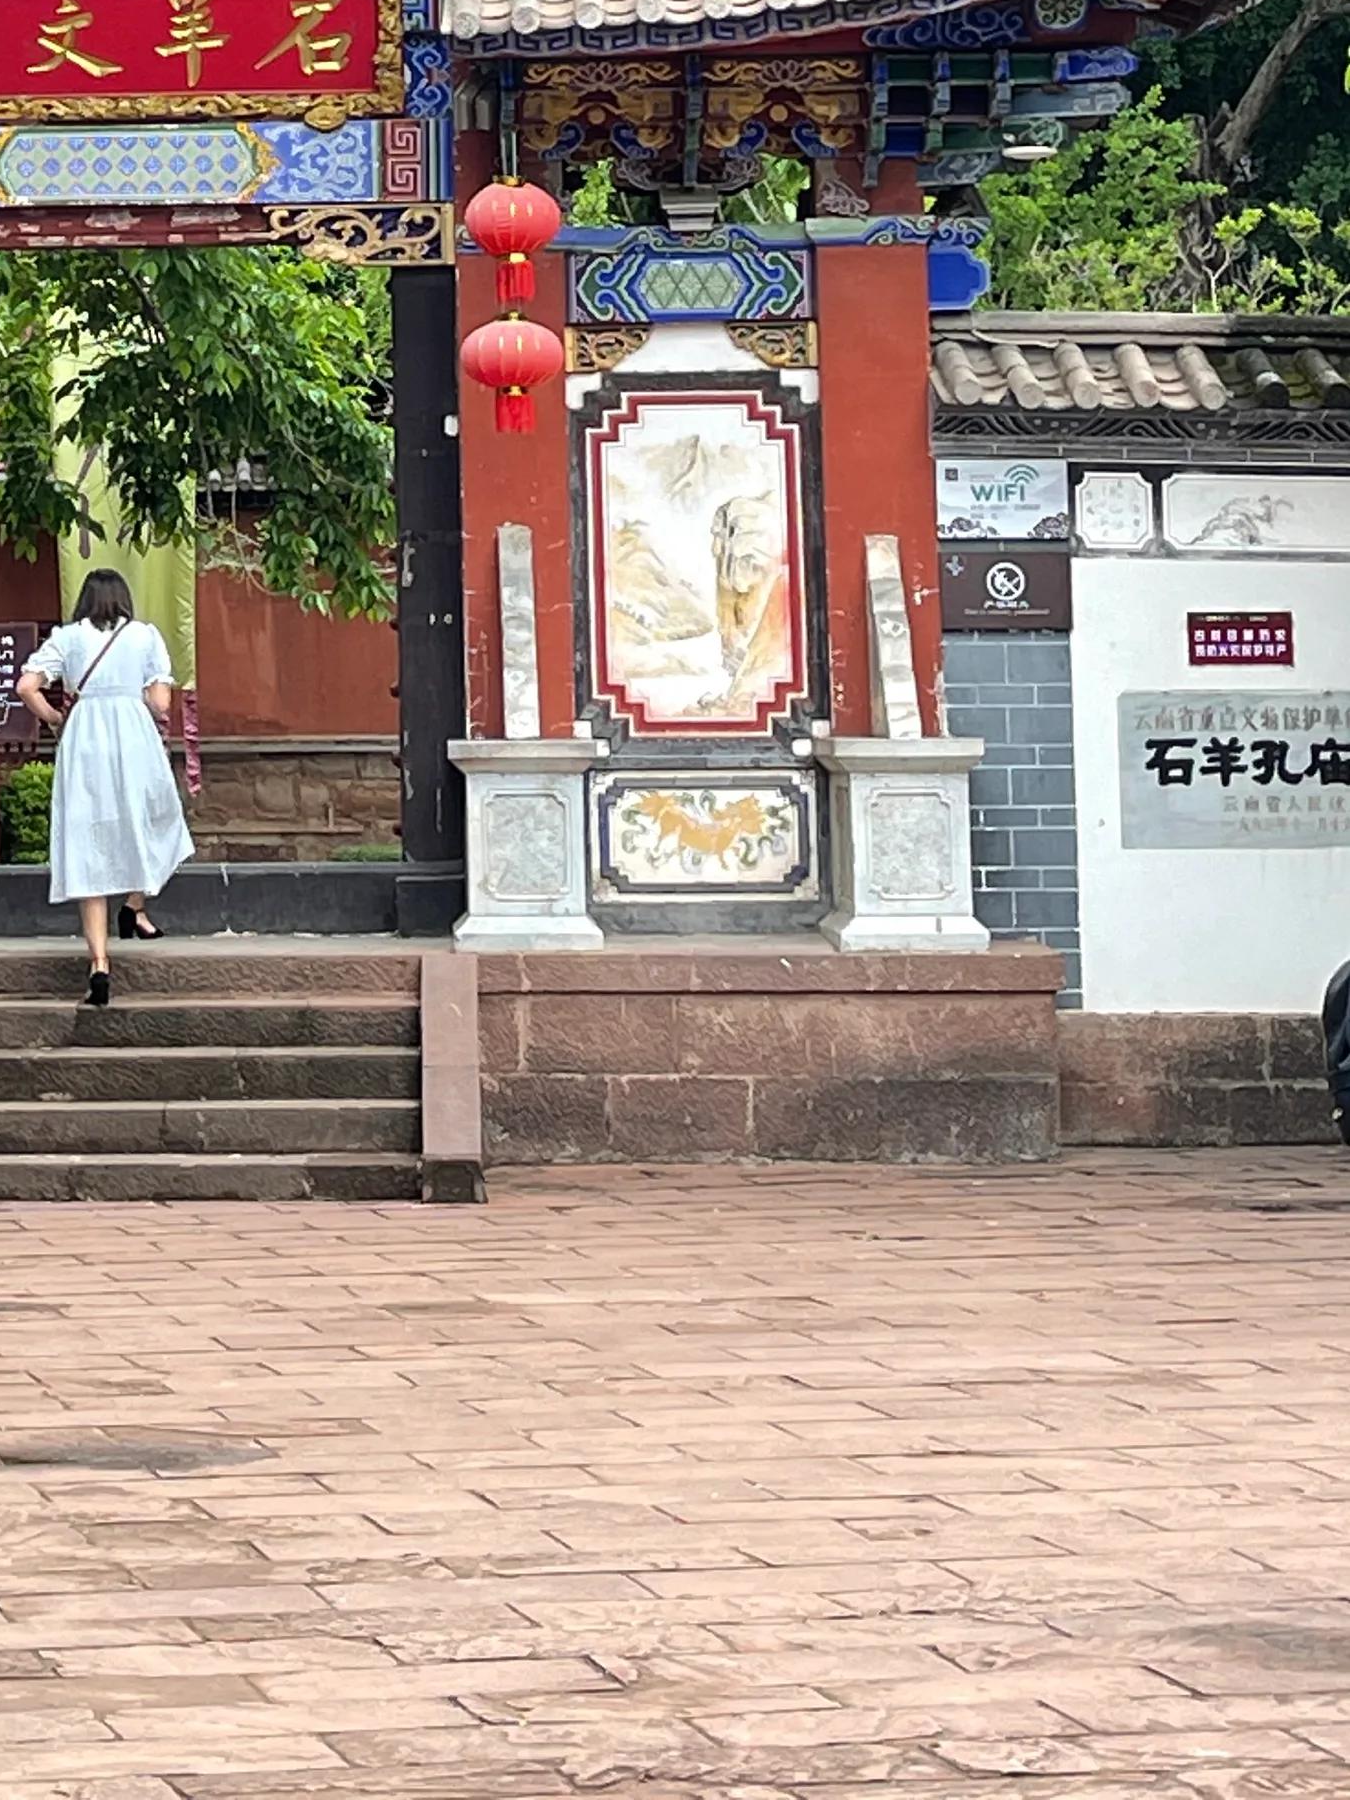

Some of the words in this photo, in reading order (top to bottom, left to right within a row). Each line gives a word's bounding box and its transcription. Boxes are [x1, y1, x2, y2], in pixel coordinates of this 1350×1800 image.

[970, 484, 1025, 502] WIFI
[1134, 706, 1350, 733] 云南省重点文物保护单
[1145, 737, 1350, 787] 石羊孔庙
